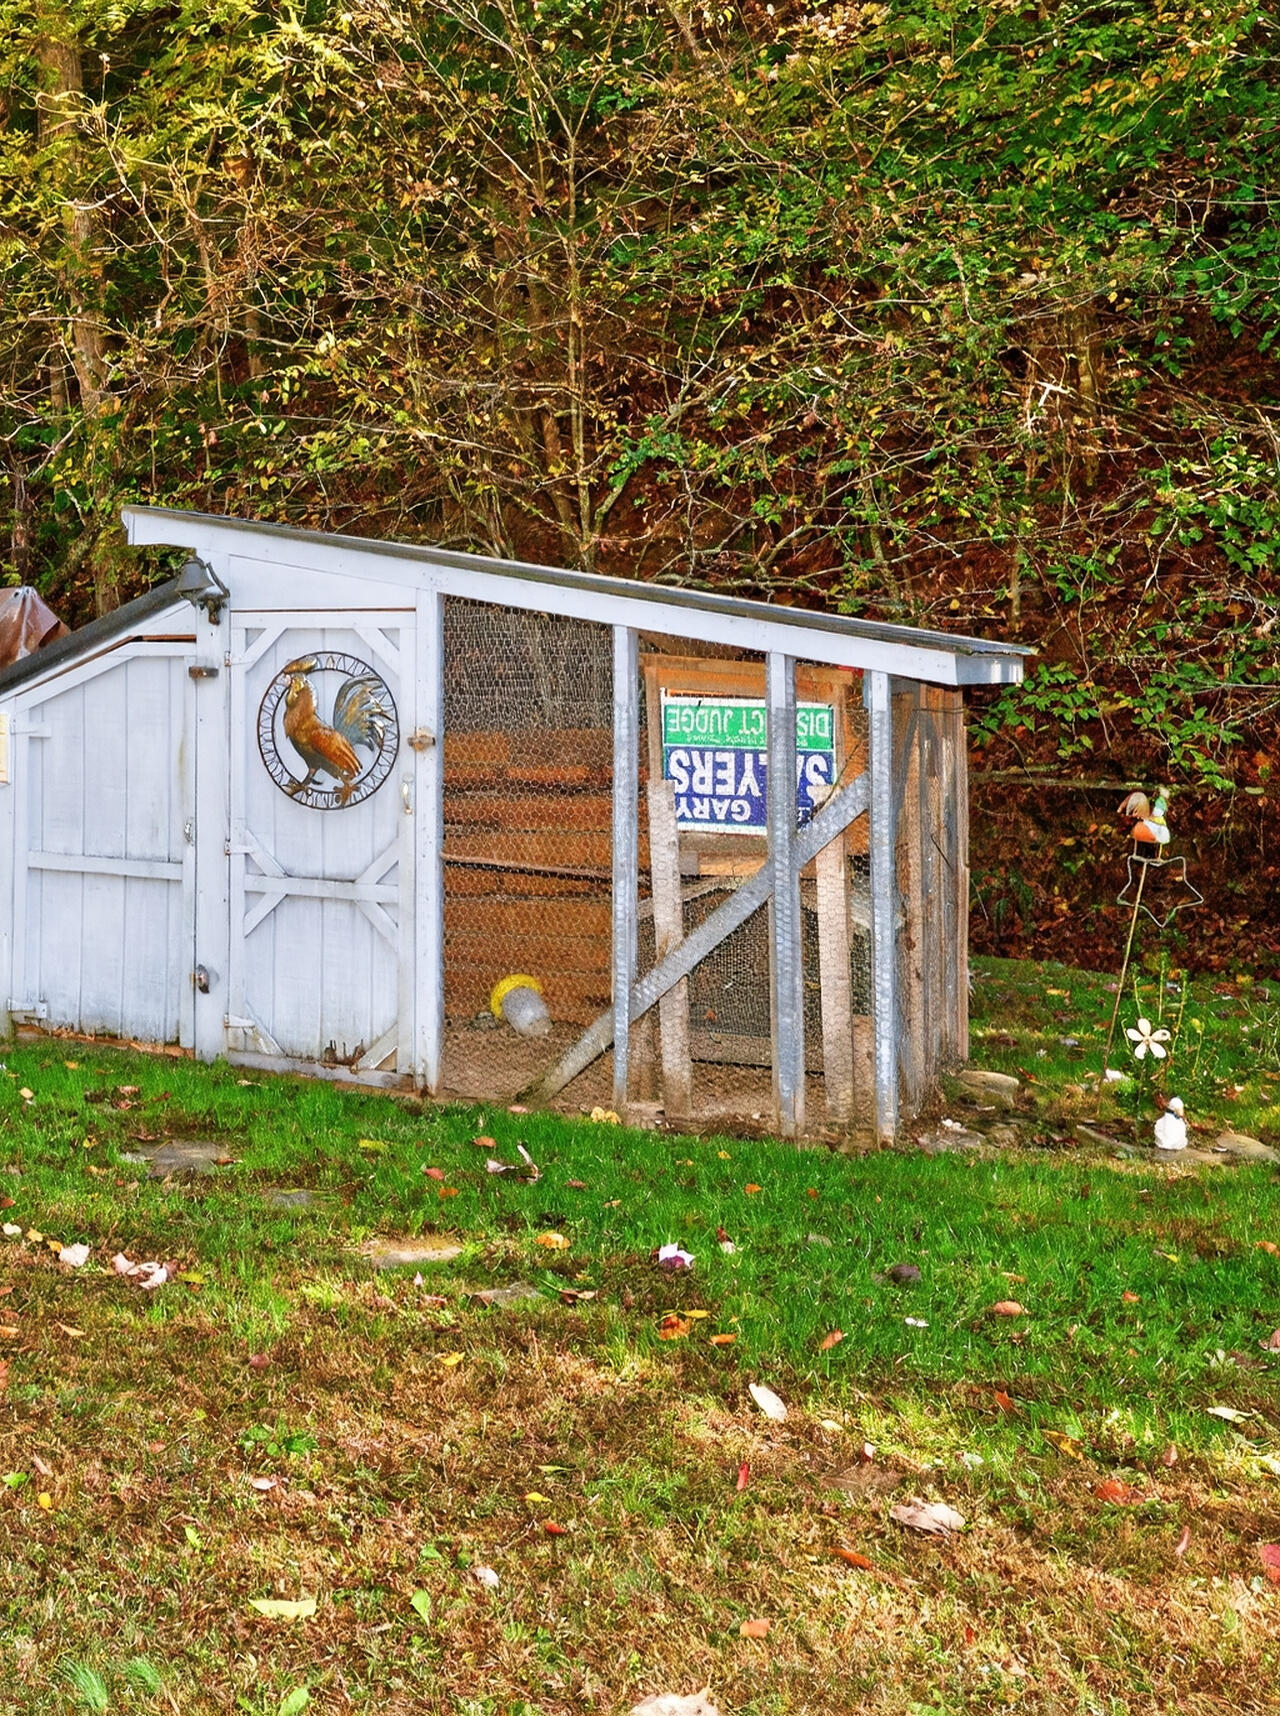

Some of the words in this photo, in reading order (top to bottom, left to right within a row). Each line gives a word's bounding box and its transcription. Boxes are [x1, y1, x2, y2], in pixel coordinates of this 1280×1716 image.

[667, 709, 733, 734] JUDGE
[739, 711, 829, 737] DISCT
[676, 797, 751, 822] GARY
